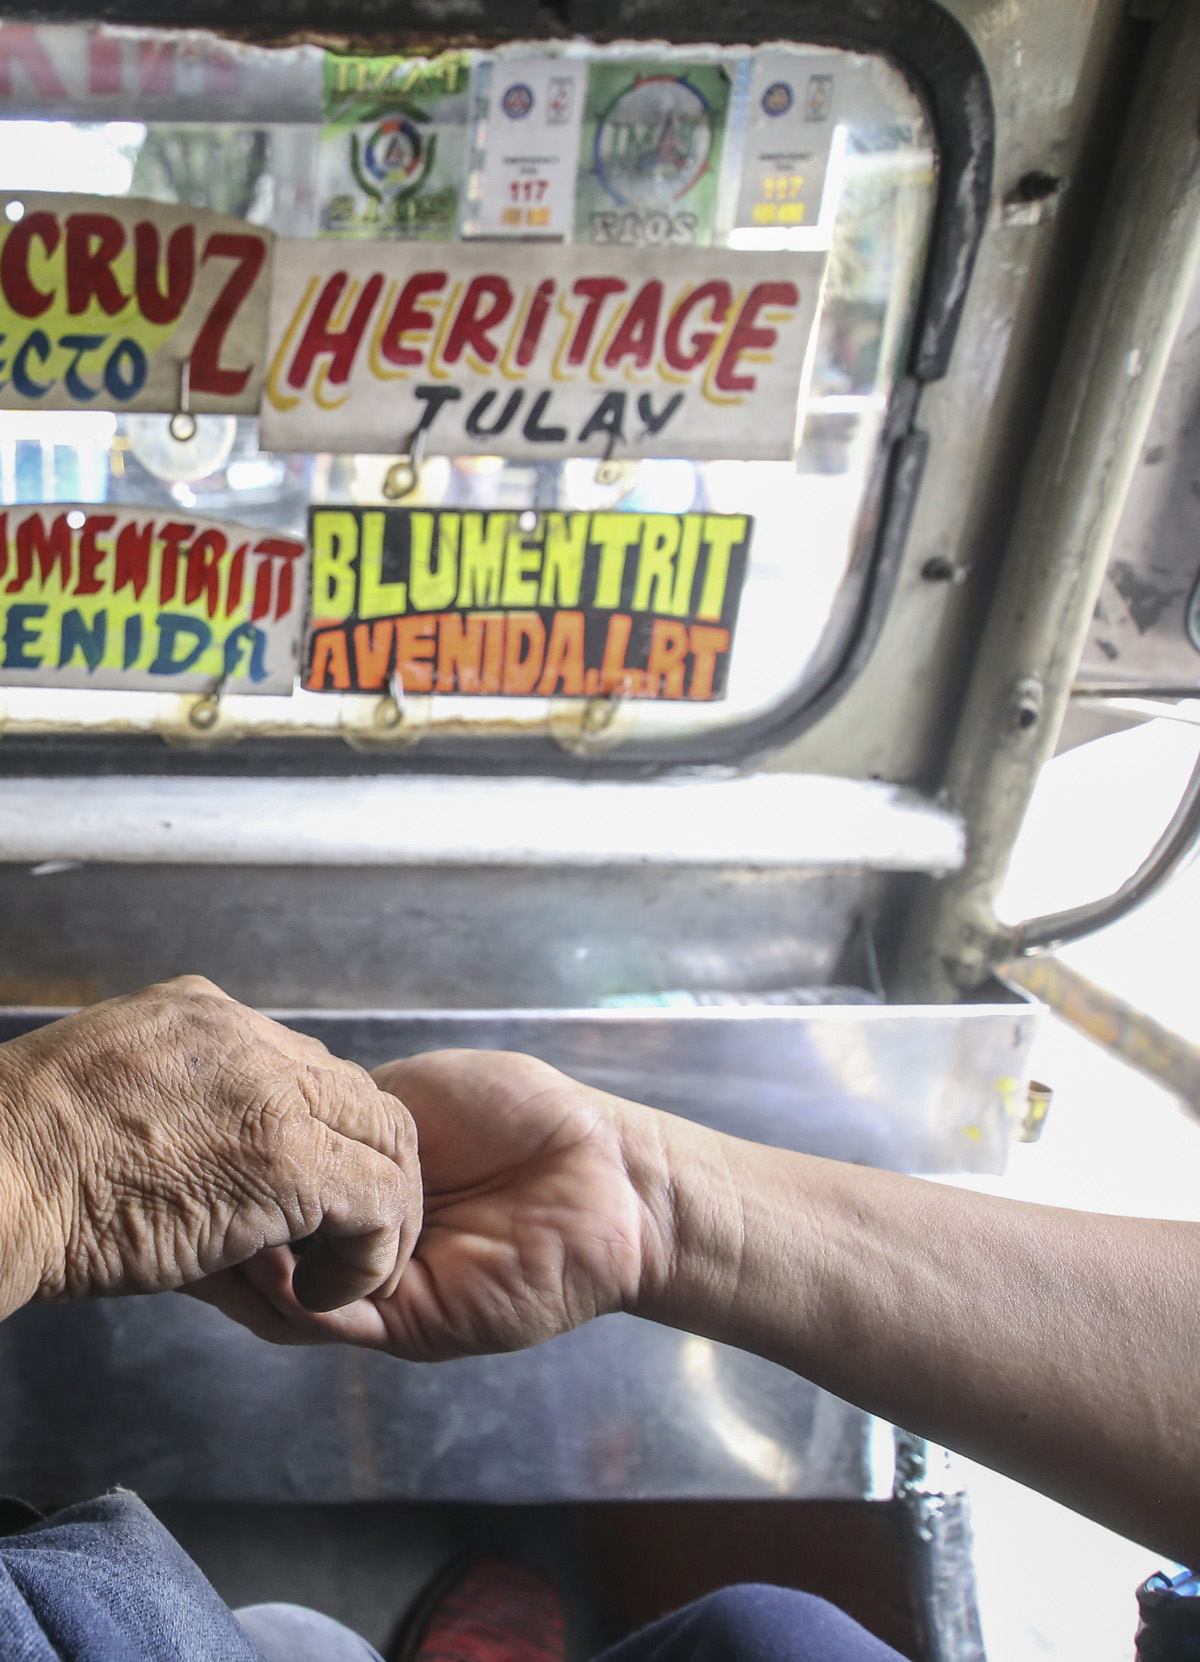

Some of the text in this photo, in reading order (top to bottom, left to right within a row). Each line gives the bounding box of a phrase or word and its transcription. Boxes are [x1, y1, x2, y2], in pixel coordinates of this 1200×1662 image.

[509, 179, 550, 202] 117
[270, 270, 800, 405] HERITAGE
[413, 385, 686, 452] TULAY
[312, 511, 747, 621] BLUMENTRIT
